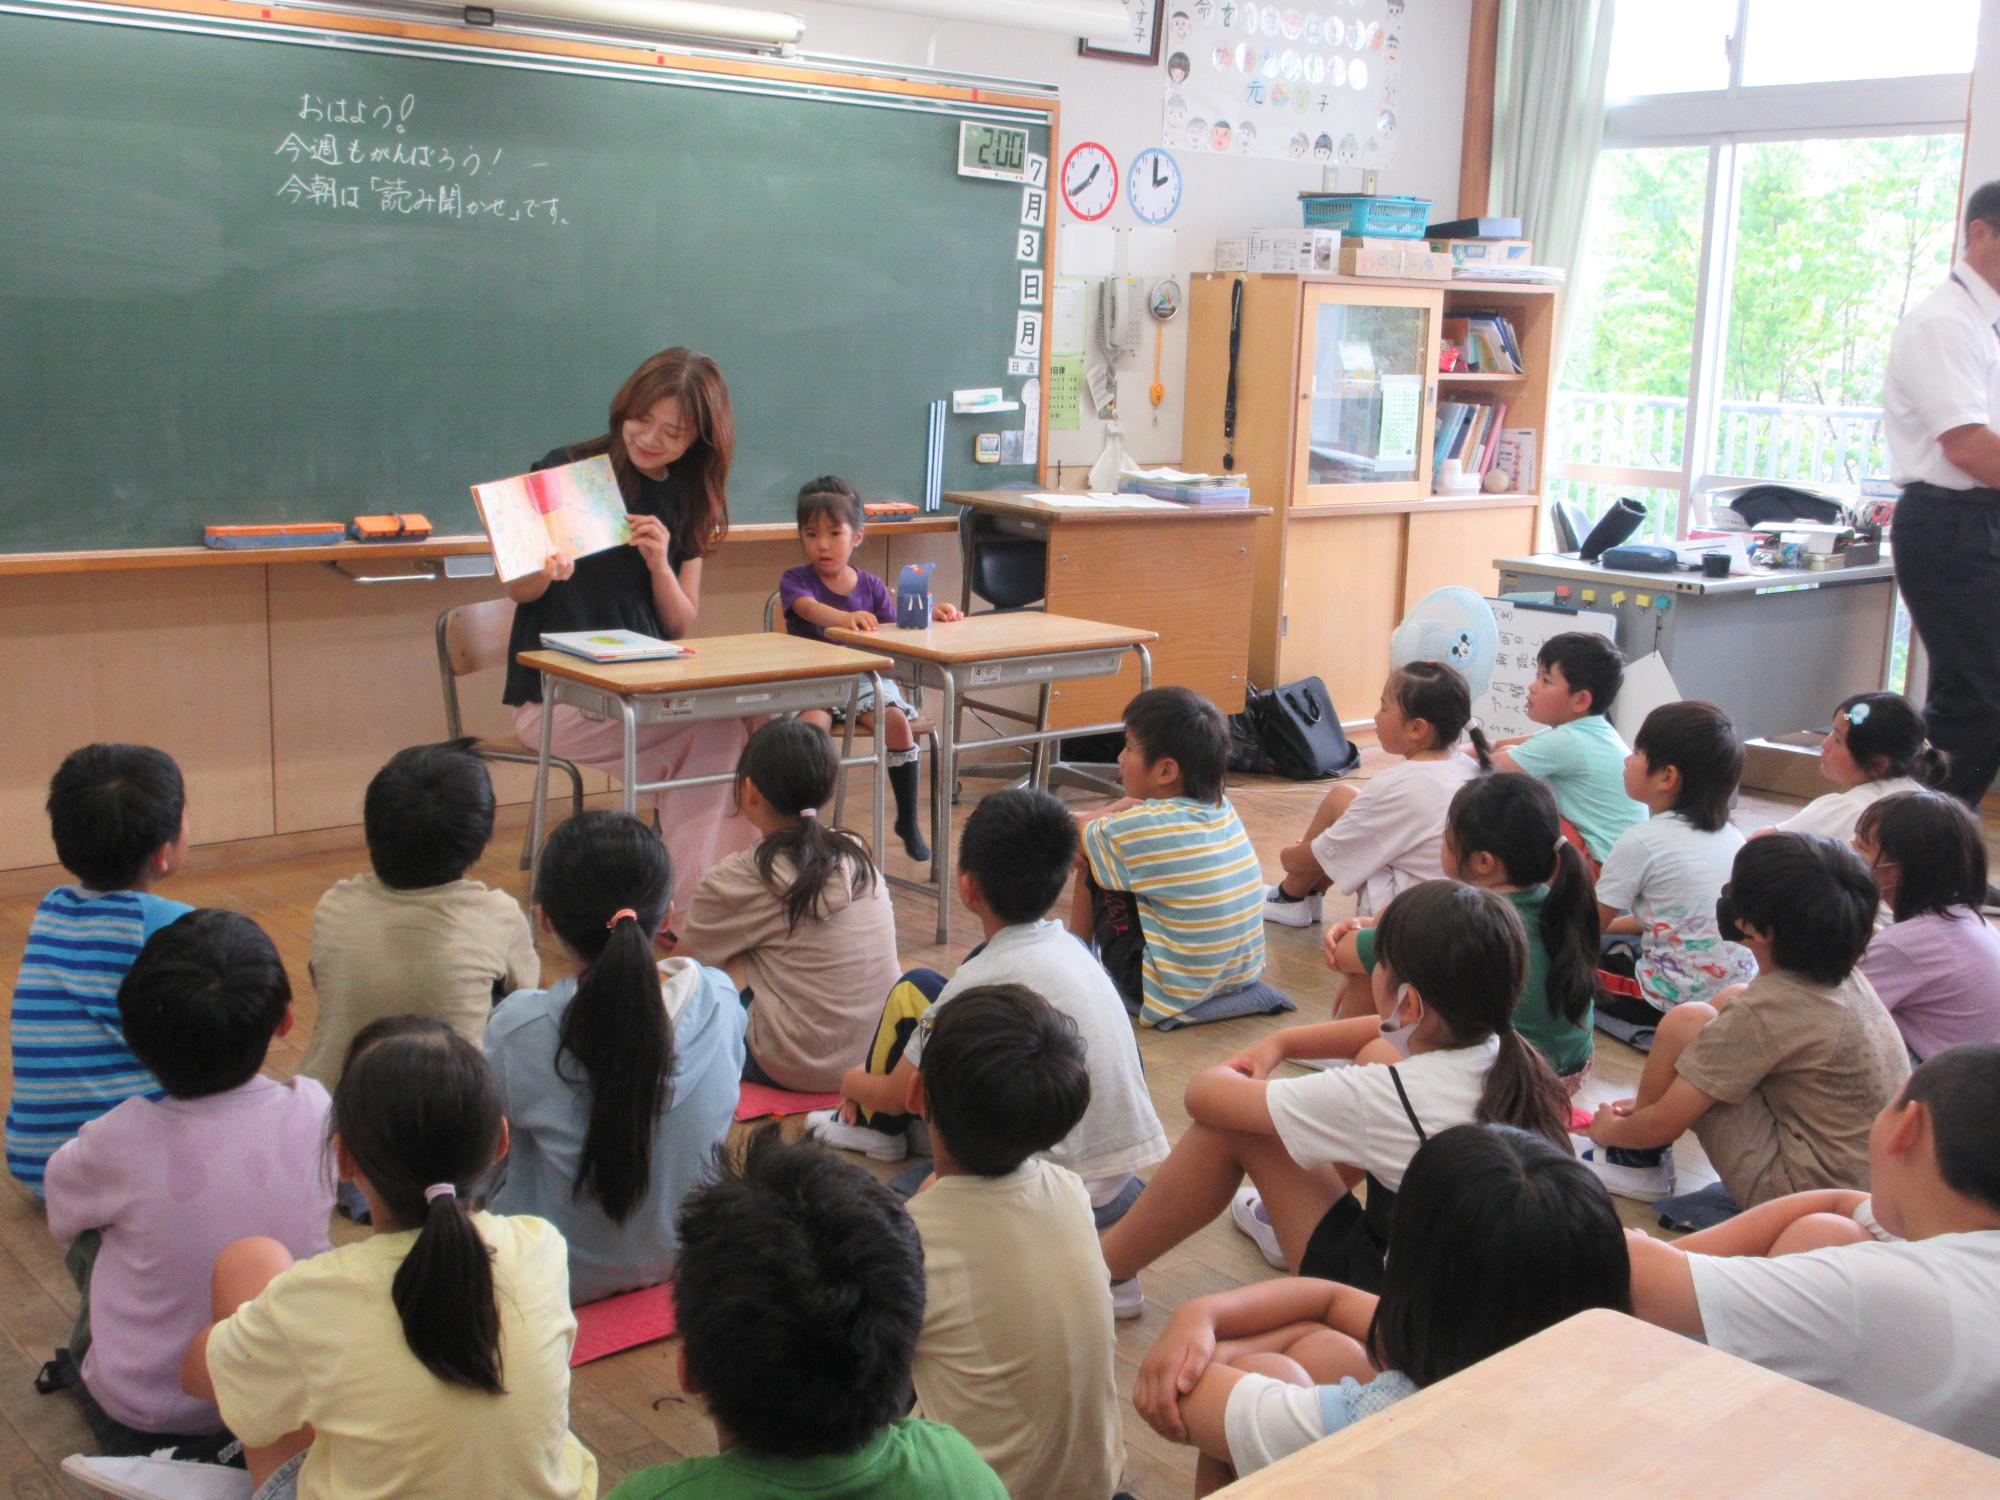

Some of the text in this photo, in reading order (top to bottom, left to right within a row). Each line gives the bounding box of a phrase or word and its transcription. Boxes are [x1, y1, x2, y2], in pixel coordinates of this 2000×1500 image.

[299, 94, 415, 134] おはよう!
[275, 133, 502, 176] 今週もがんばろう!
[978, 127, 1024, 168] 2:00
[275, 173, 569, 225] 今朝は「読み聞かせ」です。
